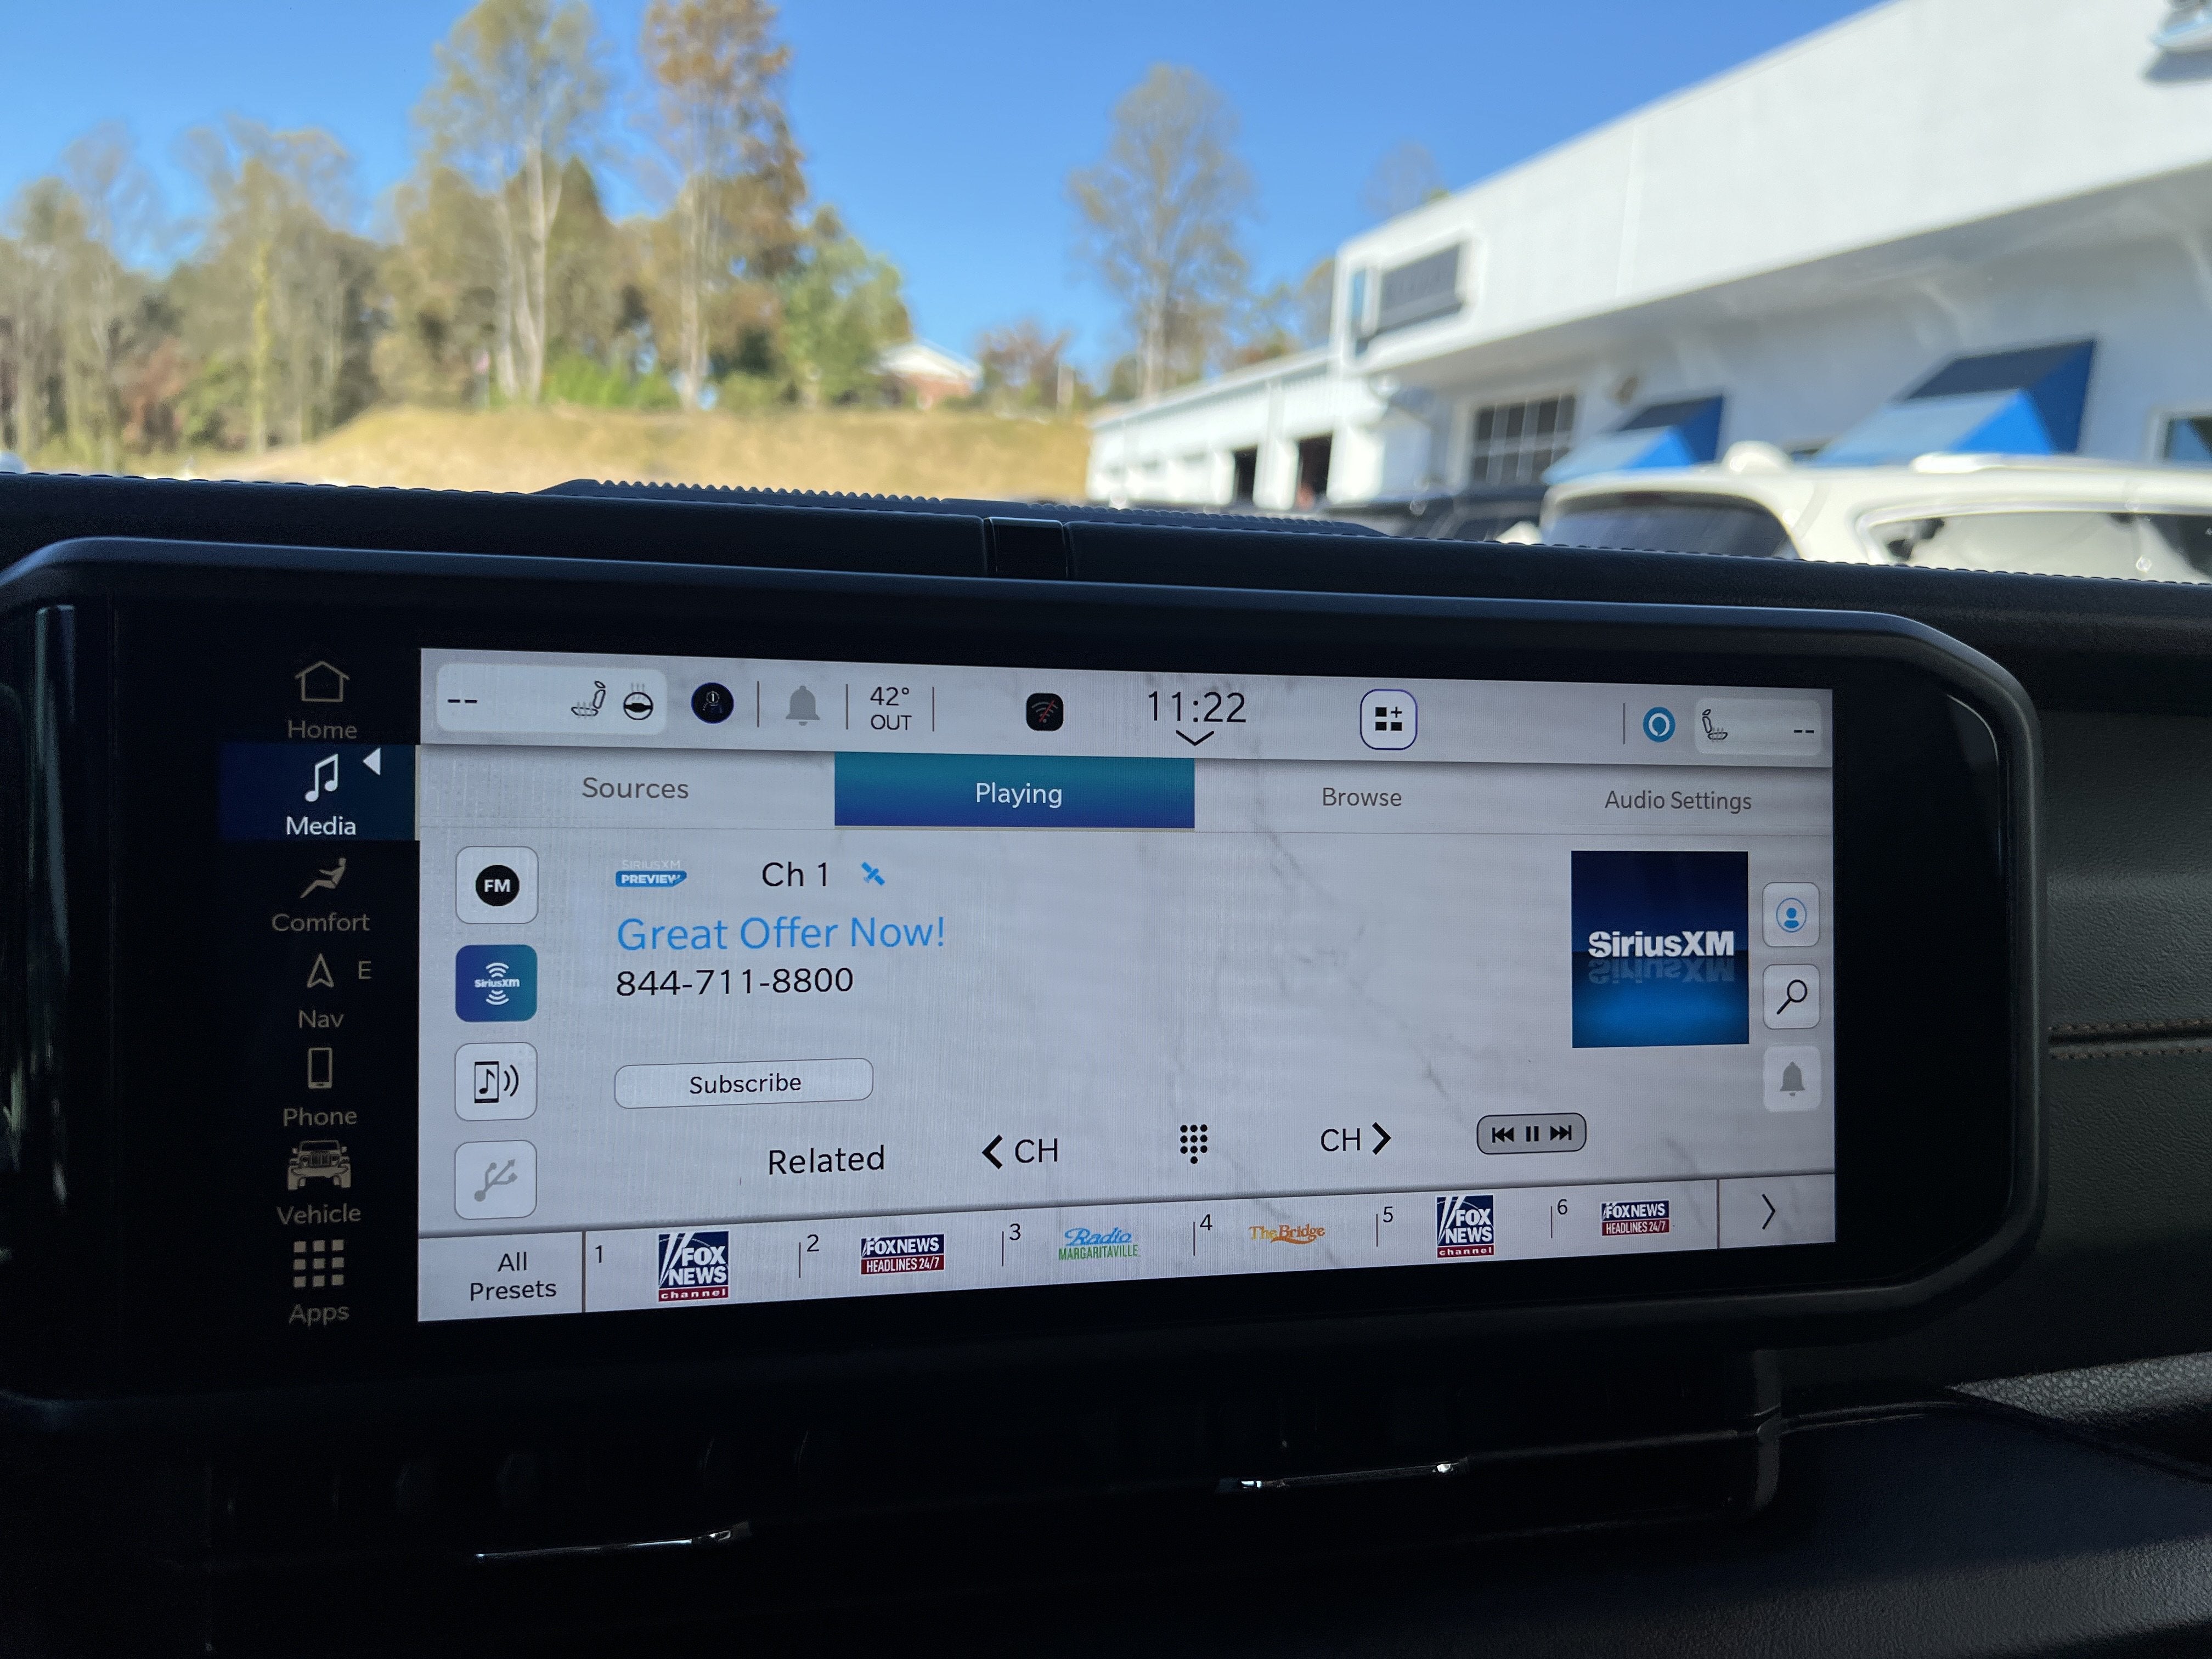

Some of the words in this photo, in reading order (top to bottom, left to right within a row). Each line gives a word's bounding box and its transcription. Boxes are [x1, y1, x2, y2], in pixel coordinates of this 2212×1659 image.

[870, 686, 909, 706] 42°
[1149, 691, 1246, 723] 11:22
[288, 720, 357, 739] Home
[871, 714, 912, 730] OUT
[583, 777, 689, 799] Sources
[977, 782, 1062, 808] Playing
[1323, 787, 1402, 806] Browse
[1604, 790, 1665, 809] Audio
[1671, 791, 1751, 814] Settings
[286, 816, 356, 835] Media
[621, 874, 681, 884] PREVIEW
[763, 861, 803, 887] Ch
[818, 862, 826, 887] 1
[485, 879, 510, 892] FM
[272, 912, 370, 931] Comfort
[618, 918, 727, 950] Great
[741, 916, 838, 949] Offer
[851, 917, 943, 947] Now!
[1588, 930, 1734, 958] SiriusXM
[359, 961, 371, 979] E
[617, 968, 853, 996] 844-711-8800
[298, 1010, 344, 1028] Nav
[690, 1073, 801, 1094] Subscribe
[284, 1108, 357, 1126] Phone
[1321, 1128, 1360, 1152] CH
[769, 1144, 884, 1175] Related
[1015, 1138, 1057, 1163] CH
[277, 1204, 360, 1224] Vehicle
[1383, 1206, 1393, 1222] 5
[1558, 1199, 1567, 1215] 6
[1200, 1214, 1212, 1231] 4
[1455, 1208, 1491, 1227] FOX
[1606, 1221, 1648, 1234] HEADLINES
[1649, 1220, 1666, 1232] 24/7
[1009, 1223, 1021, 1240] 3
[1064, 1227, 1132, 1246] Radio
[1445, 1226, 1492, 1244] NEWS
[807, 1234, 819, 1252] 2
[1059, 1244, 1139, 1260] MARGARITAVILLE
[1439, 1246, 1491, 1256] channel
[498, 1251, 526, 1272] All
[596, 1245, 602, 1263] 1
[682, 1246, 726, 1267] FOX
[866, 1257, 917, 1273] HEADLINES
[919, 1256, 939, 1270] 24/7
[668, 1266, 727, 1286] NEWS
[471, 1280, 556, 1301] Presets
[661, 1288, 726, 1299] channel
[289, 1304, 349, 1327] Apps
